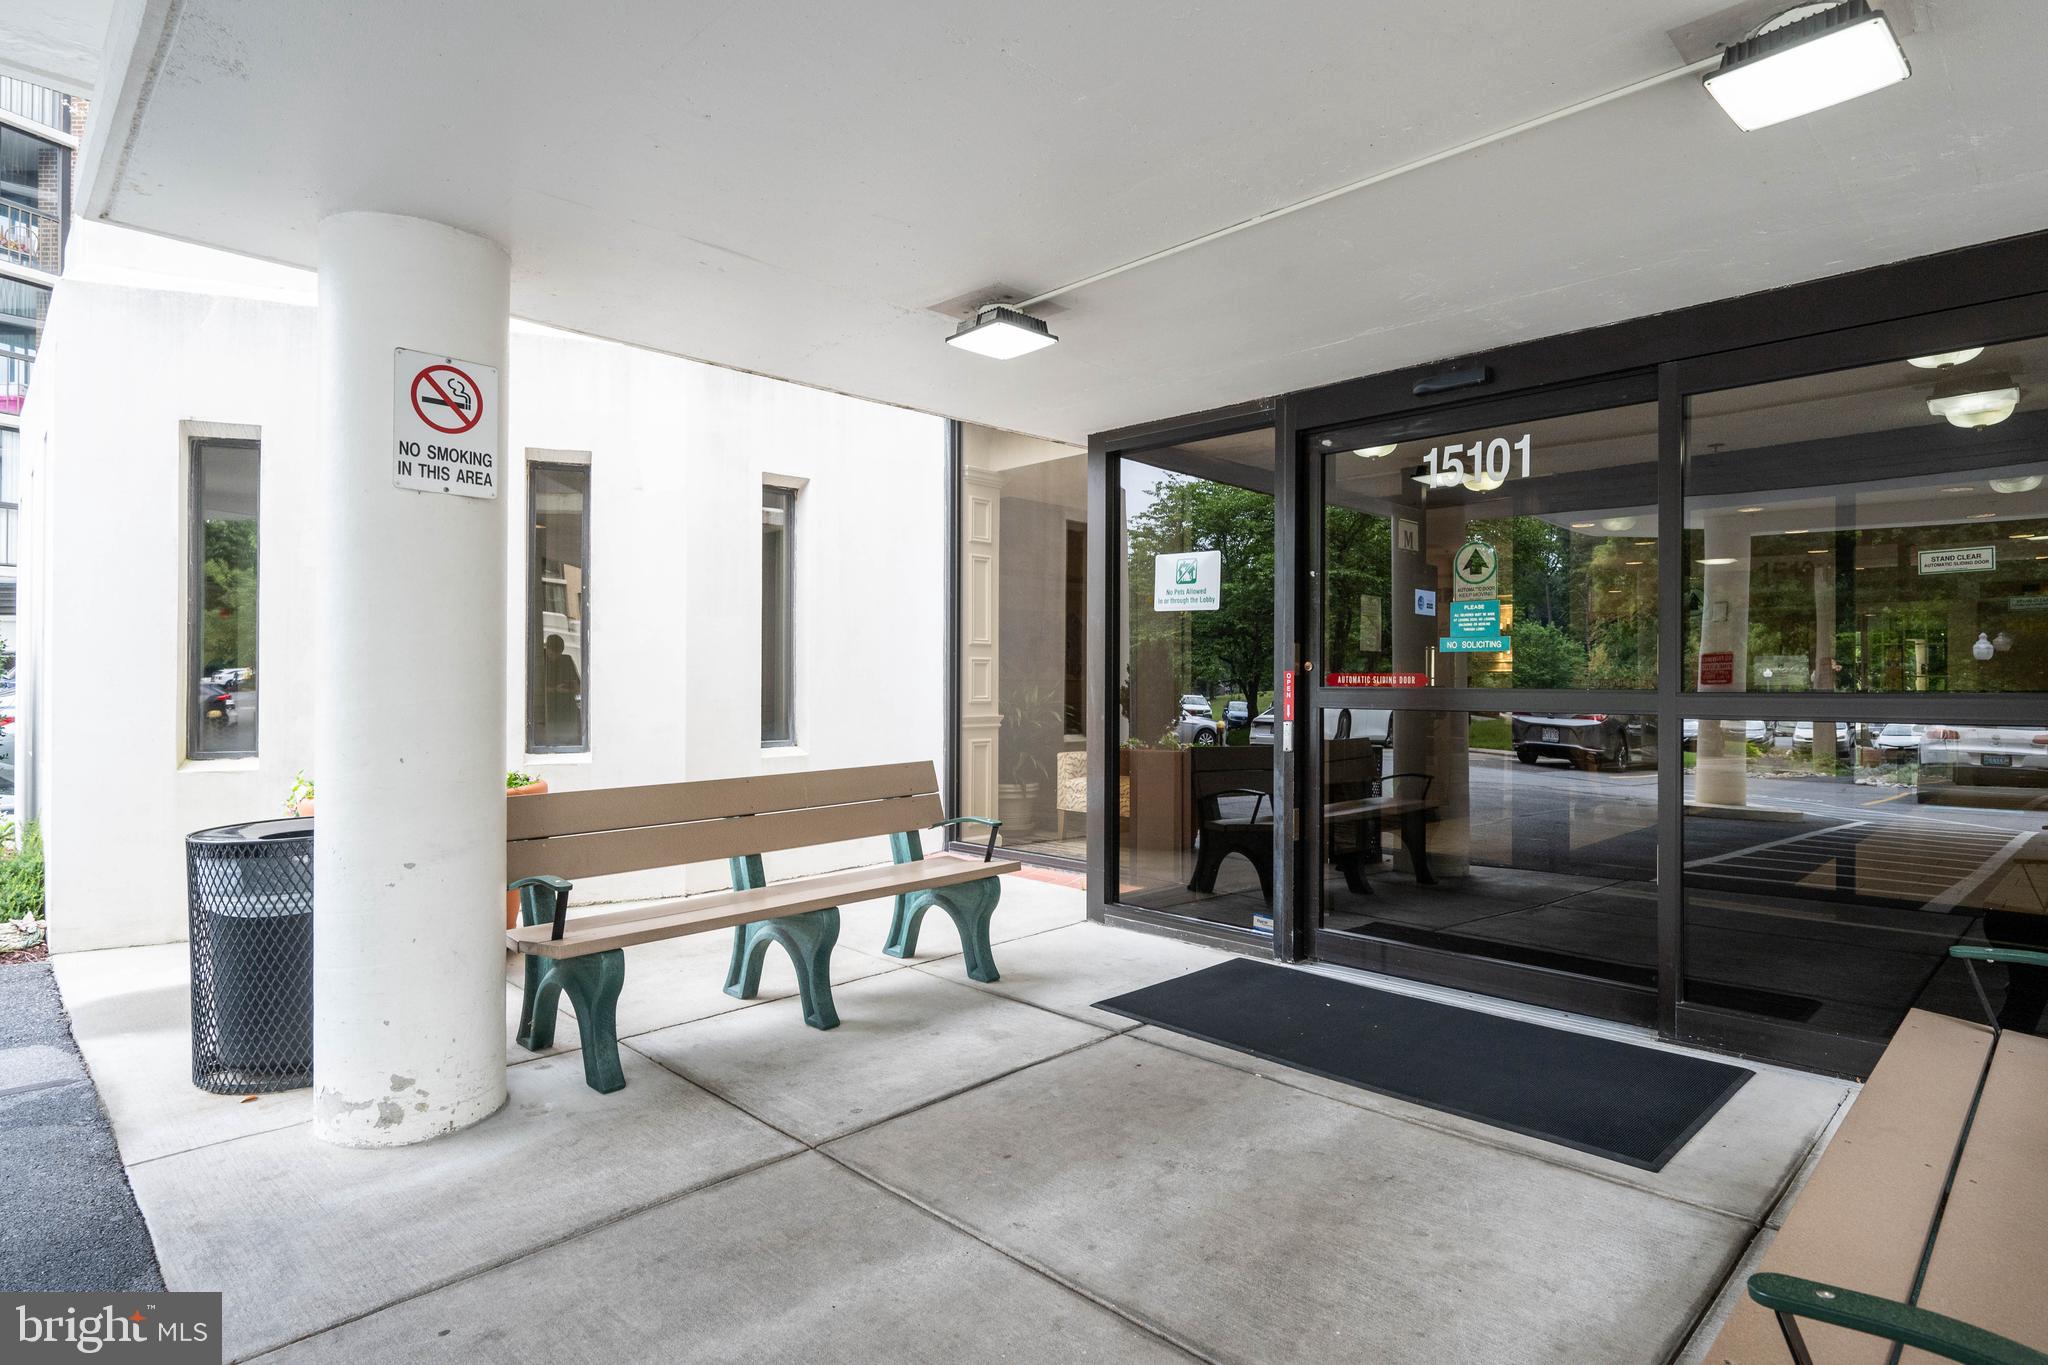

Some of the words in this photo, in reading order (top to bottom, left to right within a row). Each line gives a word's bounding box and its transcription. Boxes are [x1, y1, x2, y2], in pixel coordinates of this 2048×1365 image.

[399, 440, 420, 457] NO
[427, 444, 492, 468] SMOKING
[1423, 434, 1531, 488] 15101
[398, 460, 412, 476] IN
[418, 463, 450, 482] THIS
[456, 468, 493, 487] AREA
[1403, 530, 1414, 549] M
[1186, 587, 1207, 595] Allowed
[1200, 596, 1216, 604] Lobby
[1462, 640, 1502, 649] SOLICITING
[1337, 675, 1370, 684] AUTOMATIC
[1373, 676, 1397, 684] SLIDING
[1399, 676, 1416, 684] DOOR
